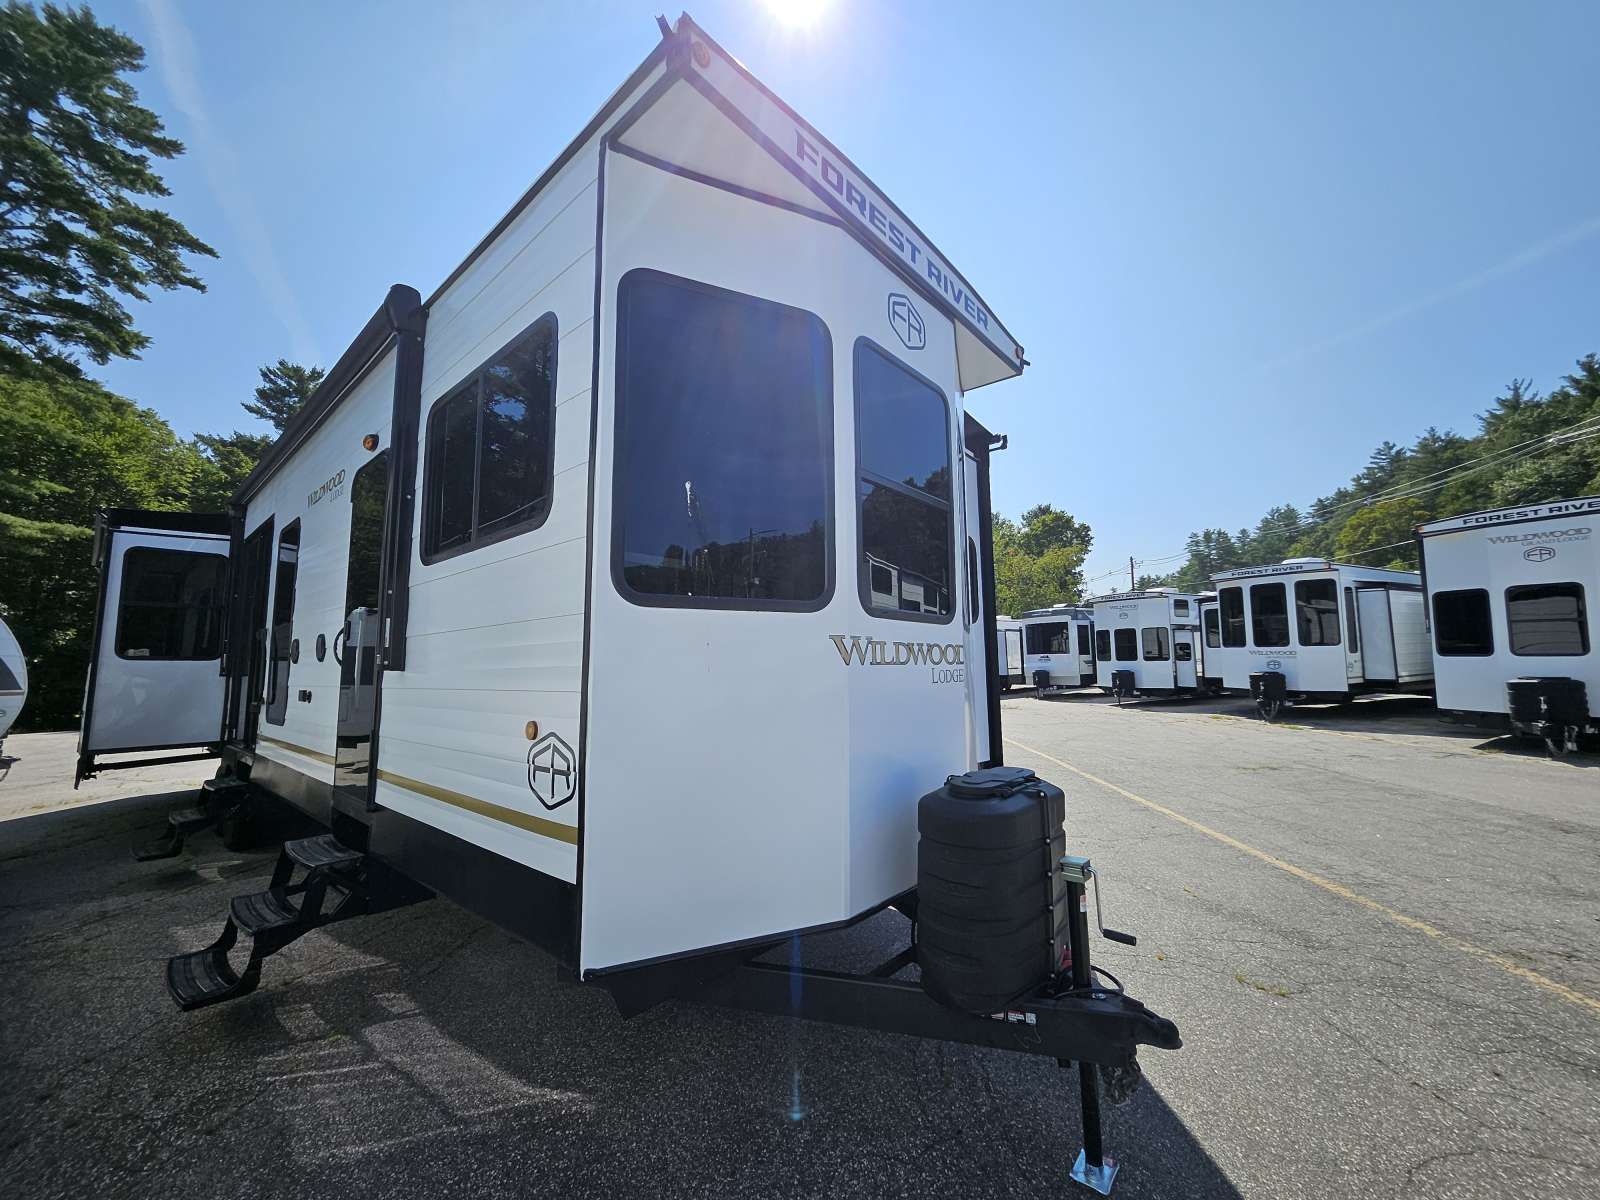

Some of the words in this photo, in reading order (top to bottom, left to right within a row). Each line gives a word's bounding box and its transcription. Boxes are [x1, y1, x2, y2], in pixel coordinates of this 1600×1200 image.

[795, 128, 921, 264] FOREST
[927, 257, 989, 330] RIVER
[1462, 508, 1543, 525] FOREST
[1548, 501, 1600, 514] RIVE
[1488, 527, 1592, 545] WILDWOOD
[1231, 568, 1269, 577] FOREST
[1271, 565, 1303, 573] RIVER
[931, 668, 965, 684] LODGE
